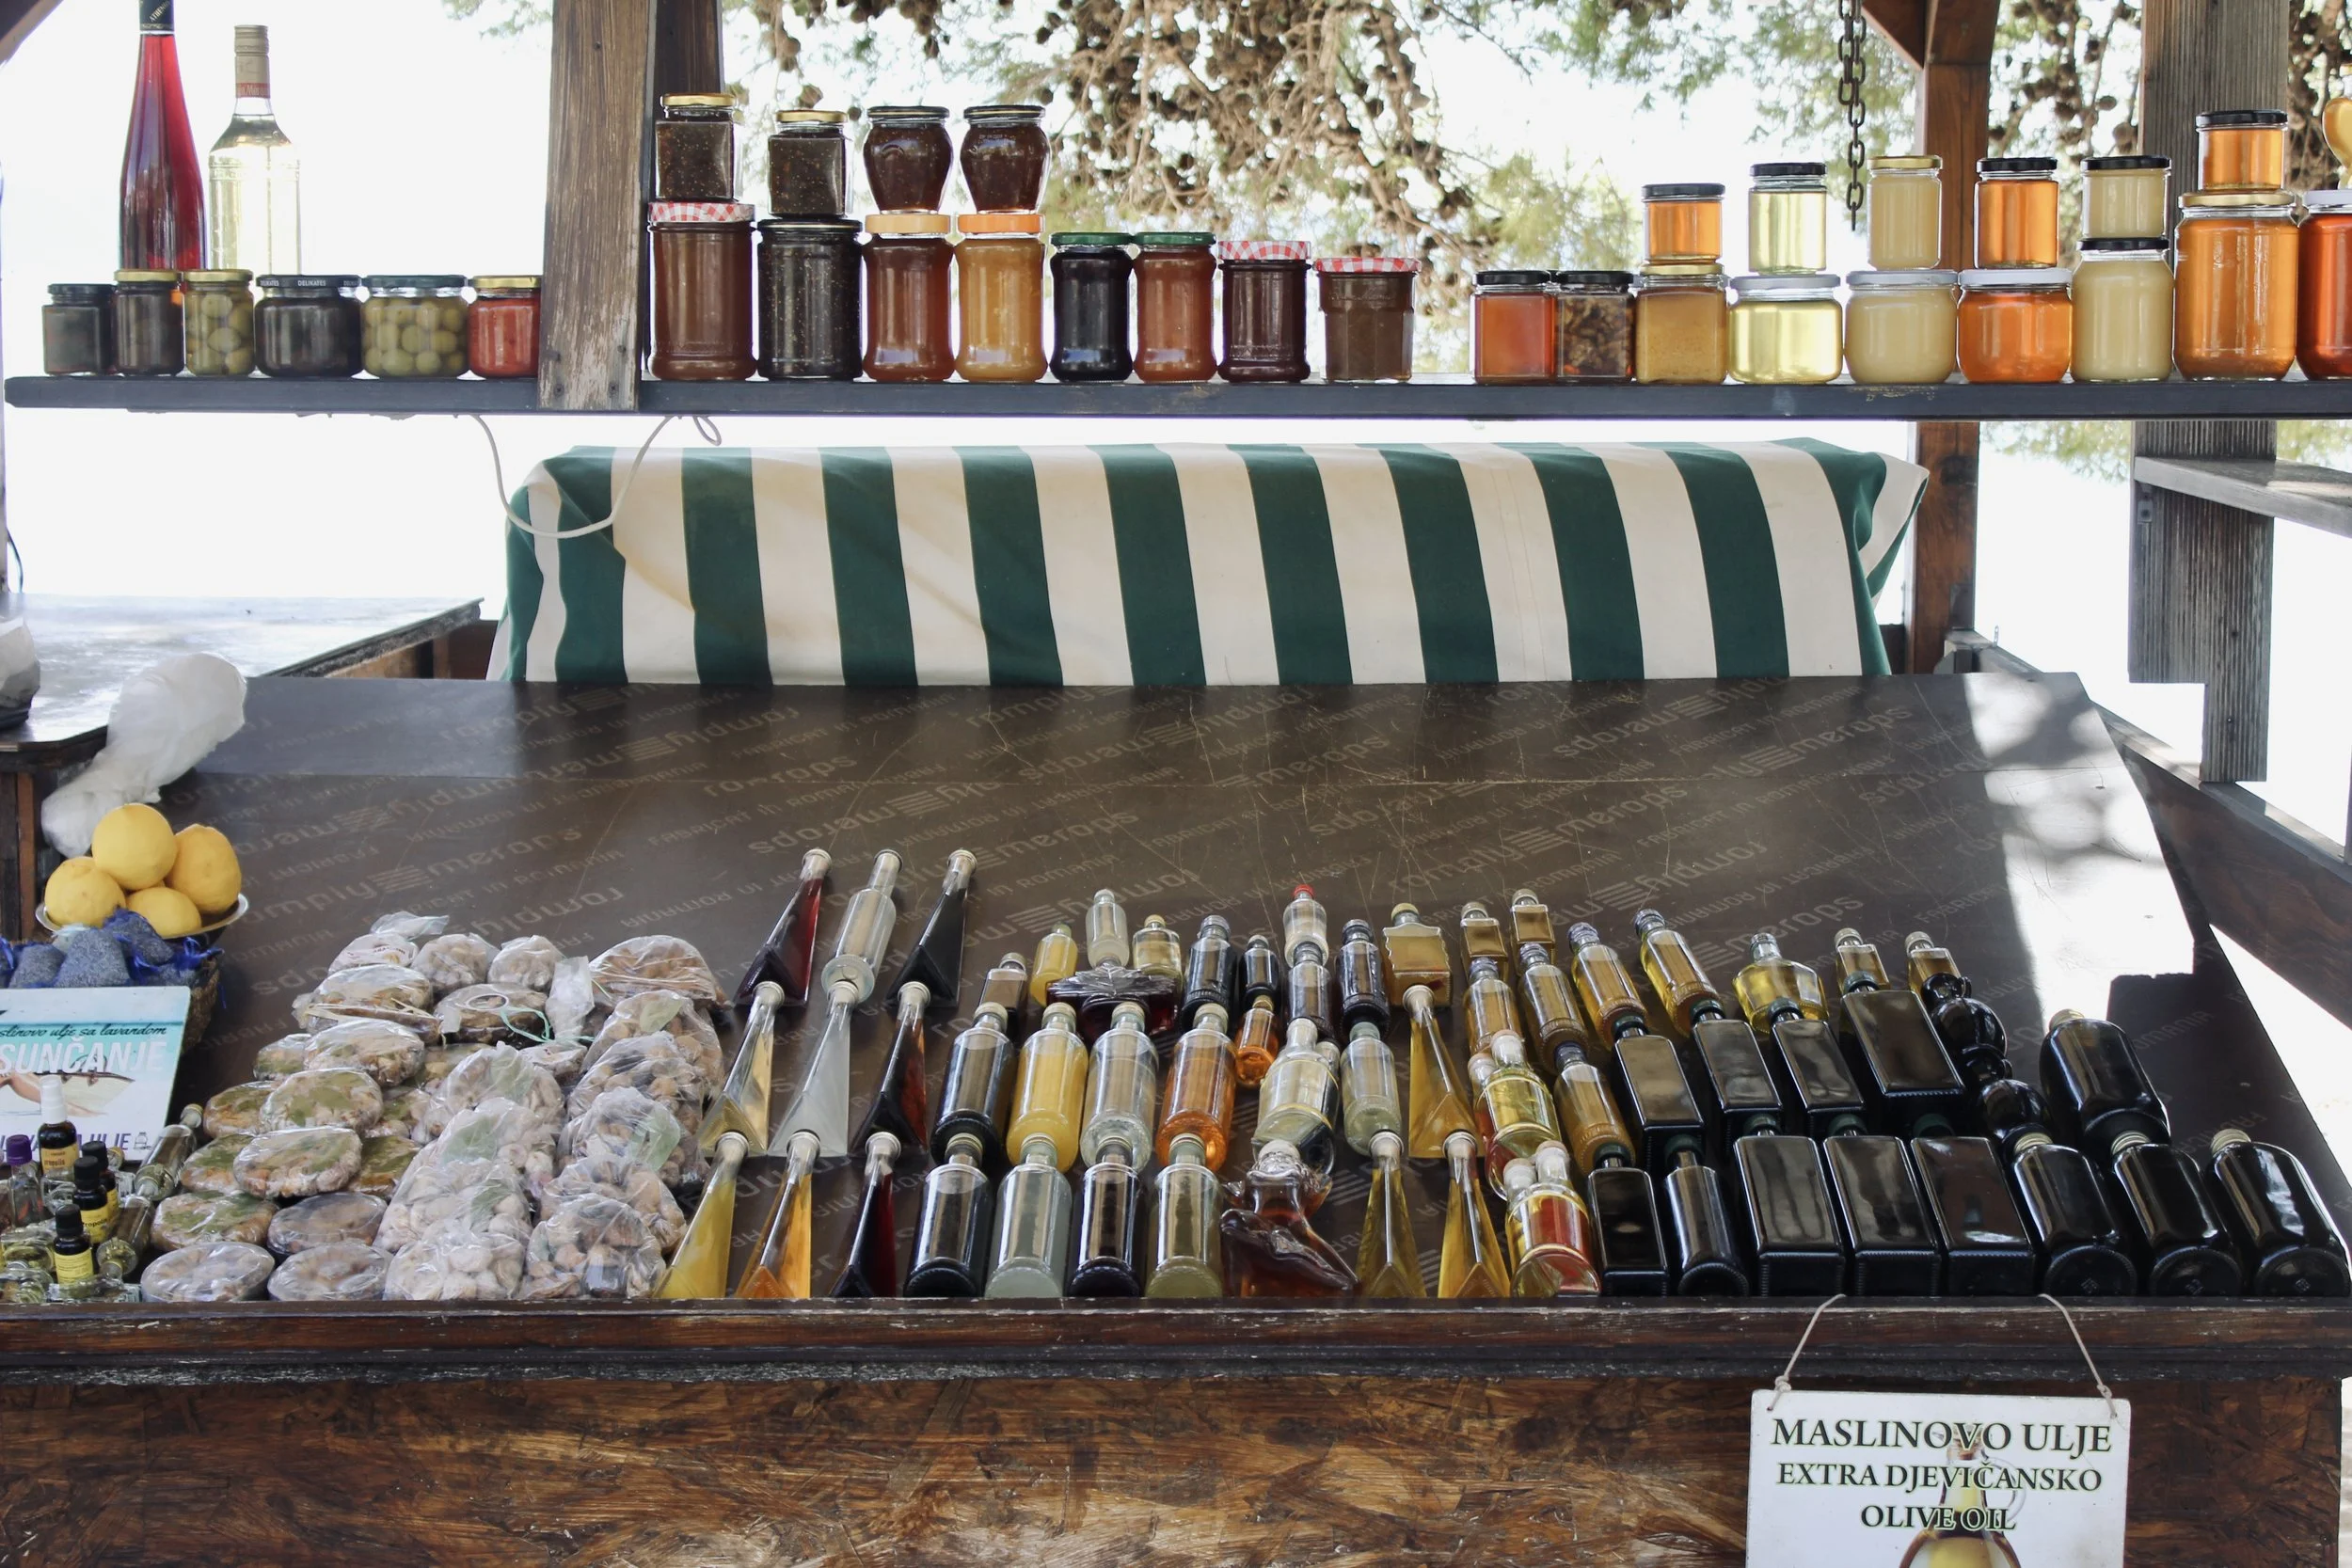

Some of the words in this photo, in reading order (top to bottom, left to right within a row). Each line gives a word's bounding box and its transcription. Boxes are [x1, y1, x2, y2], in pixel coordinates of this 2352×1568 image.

[664, 705, 801, 747] romply
[1552, 710, 1679, 757] merops
[1789, 705, 1913, 754] merops
[647, 810, 752, 847] FABRICAT
[748, 805, 897, 854] merops
[1554, 785, 1689, 836] merops
[1636, 810, 1729, 847] FABRICAT
[994, 812, 1140, 859] merops
[1635, 839, 1768, 892] romply
[620, 890, 733, 928] ROMANIA
[736, 881, 764, 896] IN
[469, 887, 626, 936] romply
[50, 1023, 76, 1040] ulje
[79, 1028, 97, 1037] sa
[99, 1022, 167, 1036] lavandom
[0, 1036, 167, 1074] SUNČANJE
[1770, 1418, 2011, 1451] MASLINOVO
[2022, 1423, 2112, 1459] ULJE
[1776, 1463, 1880, 1486] EXTRA
[1885, 1461, 2103, 1494] DJEVIČANSKO
[1860, 1504, 1957, 1530] OLIVE
[1961, 1506, 2016, 1531] OIL
